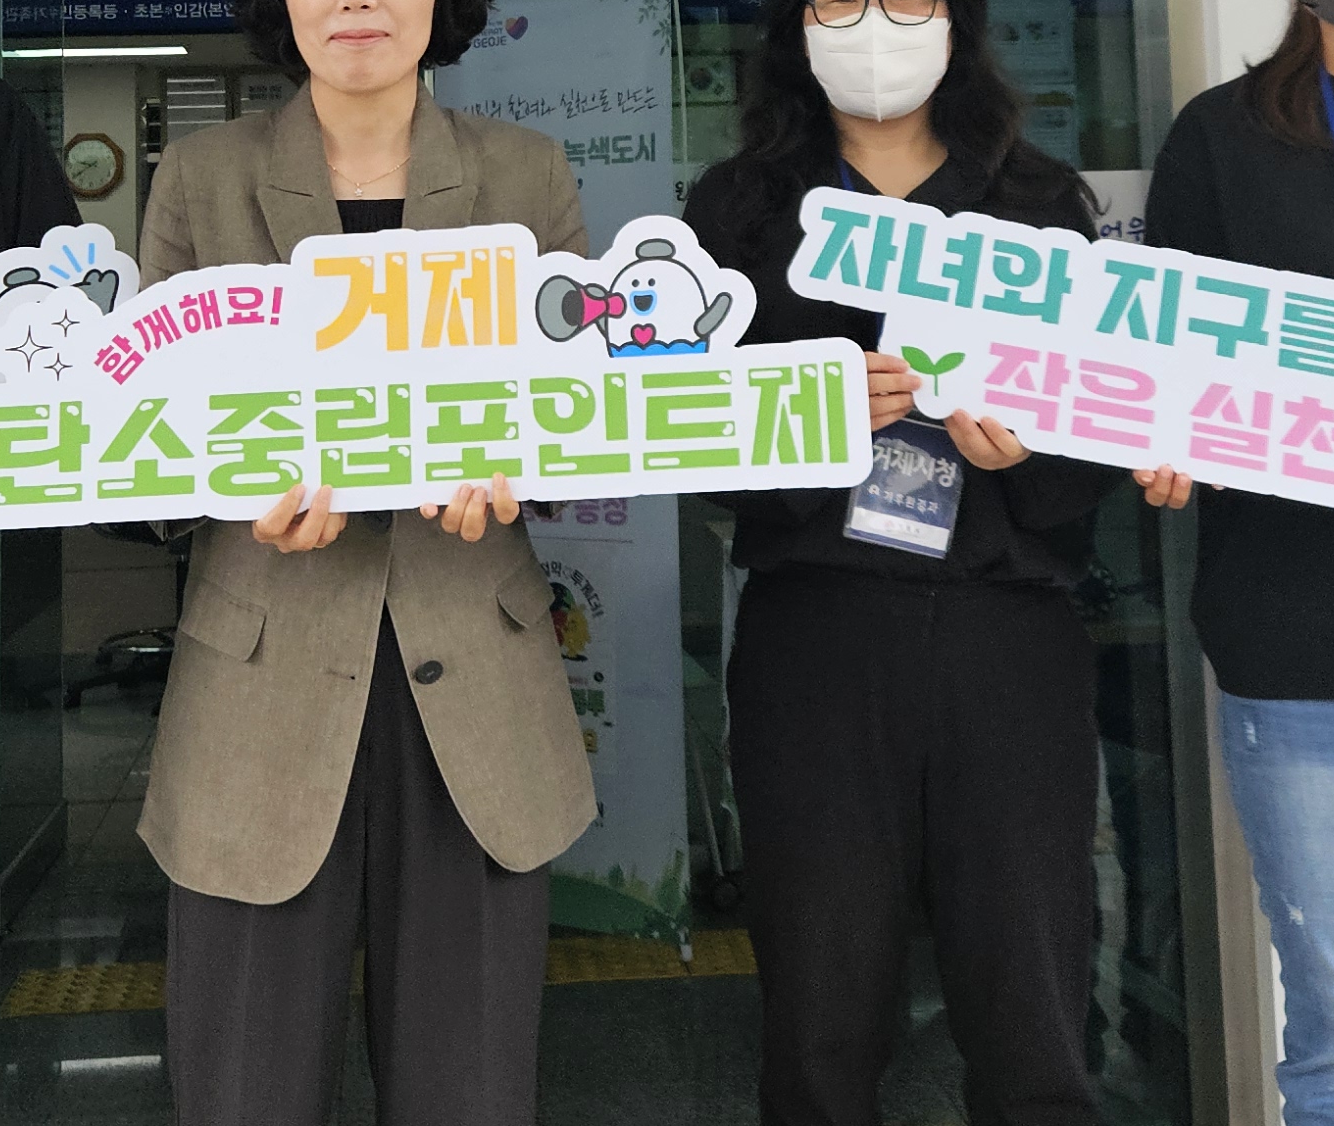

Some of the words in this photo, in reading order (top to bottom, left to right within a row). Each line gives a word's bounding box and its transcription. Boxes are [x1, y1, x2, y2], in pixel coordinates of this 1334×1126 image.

[473, 36, 507, 49] GEOJE
[507, 94, 557, 122] 참여와
[617, 86, 659, 114] 만드는
[563, 132, 656, 167] 녹색도시
[314, 246, 519, 352] 거제
[809, 205, 1072, 325] 자녀와
[93, 285, 284, 386] 함께해요!
[982, 340, 1158, 451] 작은
[872, 445, 958, 488] 거제시청
